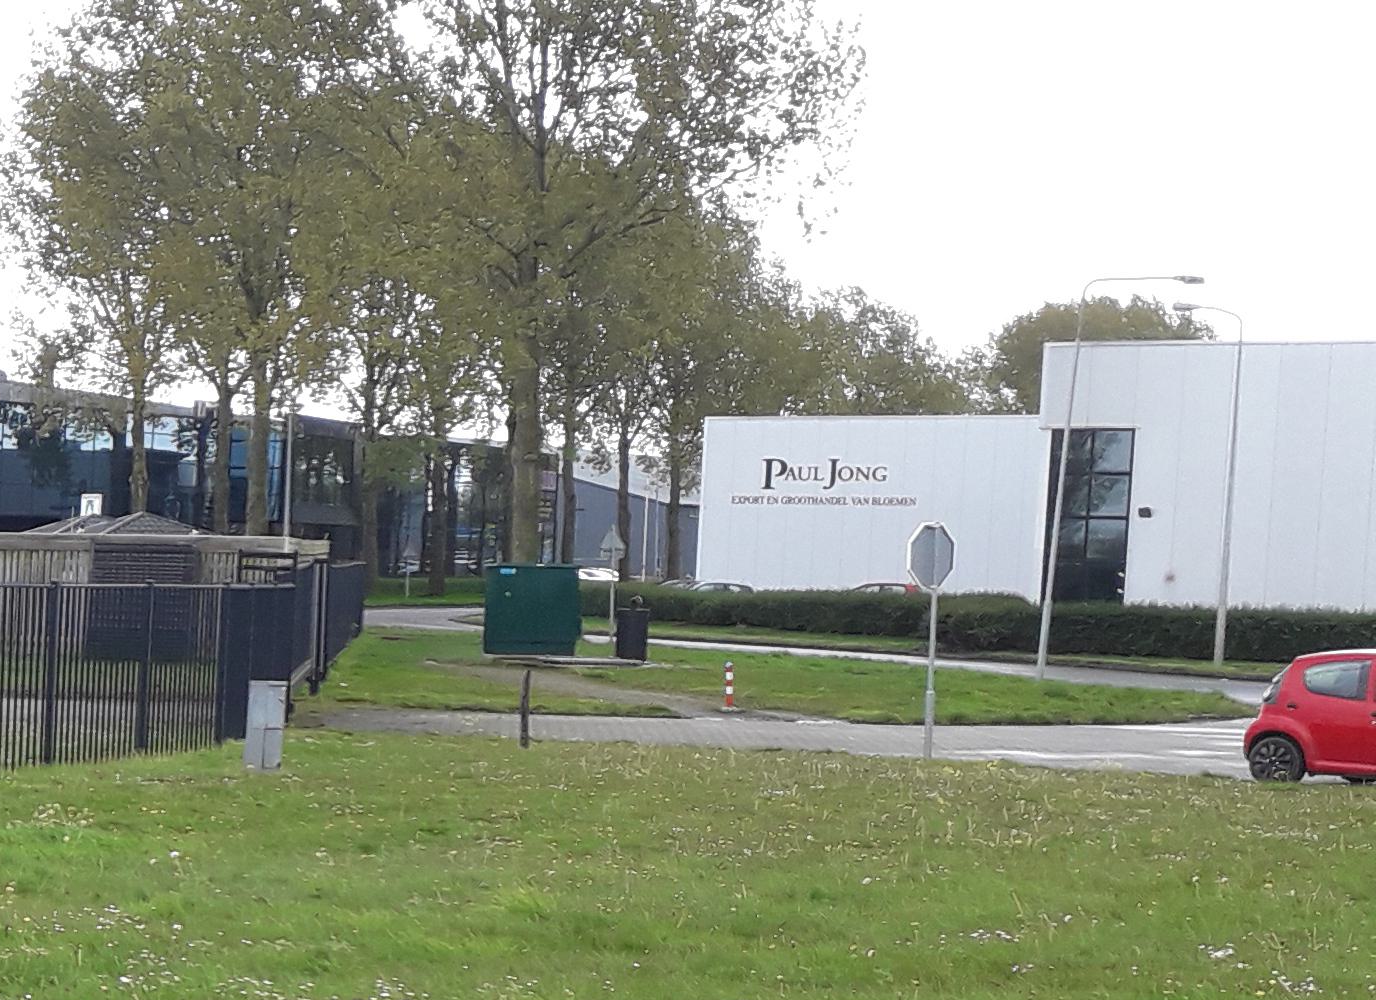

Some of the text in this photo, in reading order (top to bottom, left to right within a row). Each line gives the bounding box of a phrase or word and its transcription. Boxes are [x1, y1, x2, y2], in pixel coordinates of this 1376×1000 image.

[731, 495, 918, 507] EXPORT EN GROOTHANDEL VAN BLOEMEN
